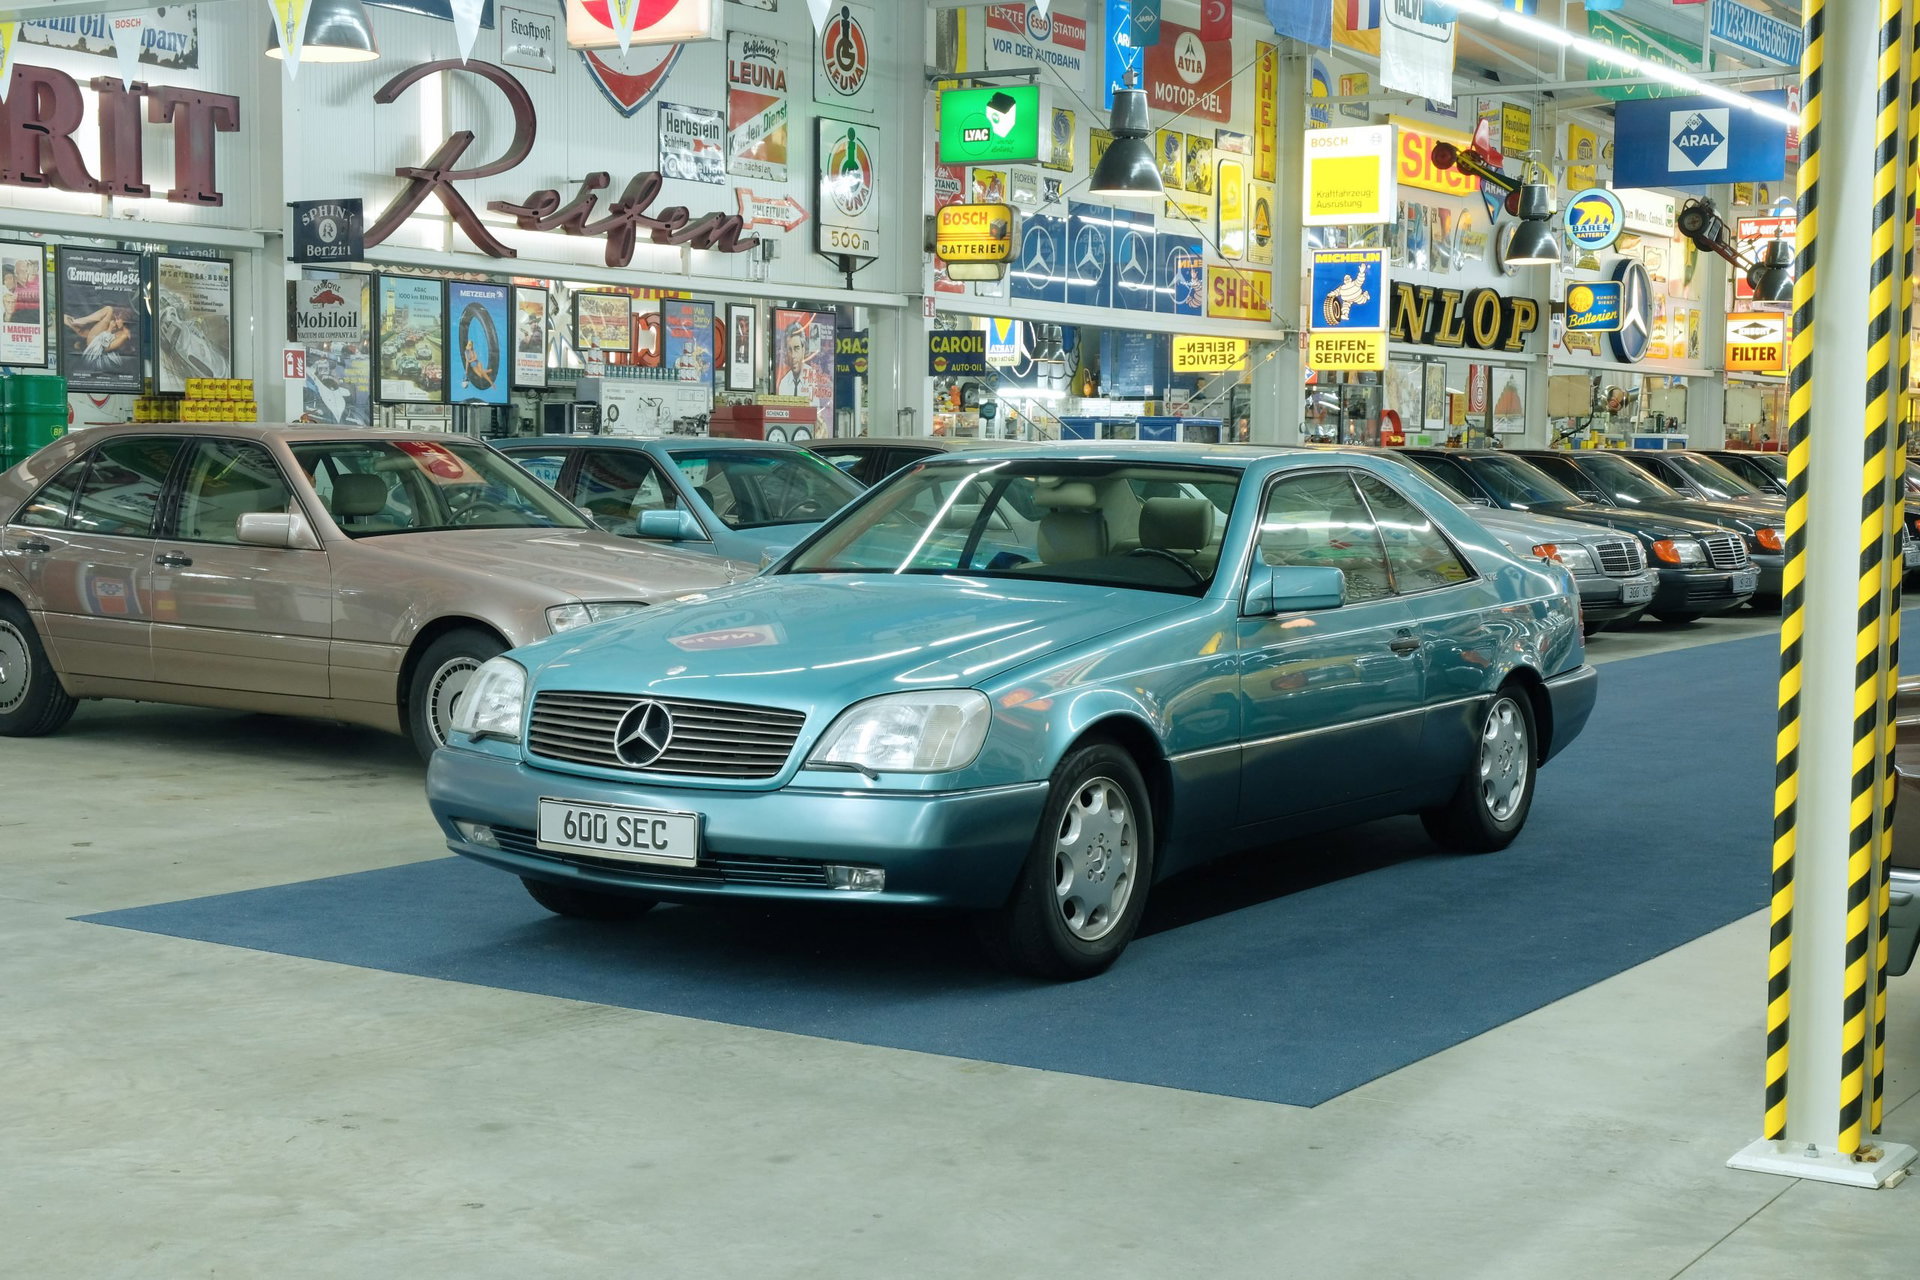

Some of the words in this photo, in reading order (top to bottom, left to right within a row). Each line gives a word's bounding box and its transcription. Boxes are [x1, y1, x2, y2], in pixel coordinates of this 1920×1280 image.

[115, 18, 142, 29] BOSCH
[1053, 21, 1086, 41] STATION
[993, 37, 1012, 55] VOR
[1015, 43, 1033, 59] DER
[1035, 48, 1080, 71] AUTOBAHN
[1177, 55, 1204, 74] AVIA
[729, 59, 788, 93] LEUNA
[826, 59, 865, 91] LEUNA
[1259, 45, 1275, 179] SHELL
[666, 111, 720, 140] Herbstein
[964, 129, 989, 141] LYAC
[1311, 136, 1348, 148] BOSCH
[1679, 134, 1719, 148] ARAL
[362, 58, 761, 268] Reifen
[943, 212, 988, 225] BOSCH
[832, 231, 860, 250] 500
[863, 240, 870, 251] m
[942, 244, 1005, 254] BATTERIEN
[1315, 253, 1380, 263] MICHELIN
[66, 266, 128, 286] Emmanuelle
[128, 273, 140, 286] 84
[460, 290, 496, 299] METZELER
[1214, 276, 1267, 311] SHELL
[297, 311, 357, 328] Mobiloil
[1568, 309, 1618, 328] Batterien
[931, 336, 984, 353] CAROIL
[1315, 340, 1375, 351] REIFEN-
[1315, 352, 1375, 364] SERVICE
[1732, 347, 1777, 361] FILTER
[951, 364, 983, 372] AUTO-OIL
[54, 427, 63, 436] BP
[563, 810, 608, 844] 600
[616, 816, 668, 850] SEC
